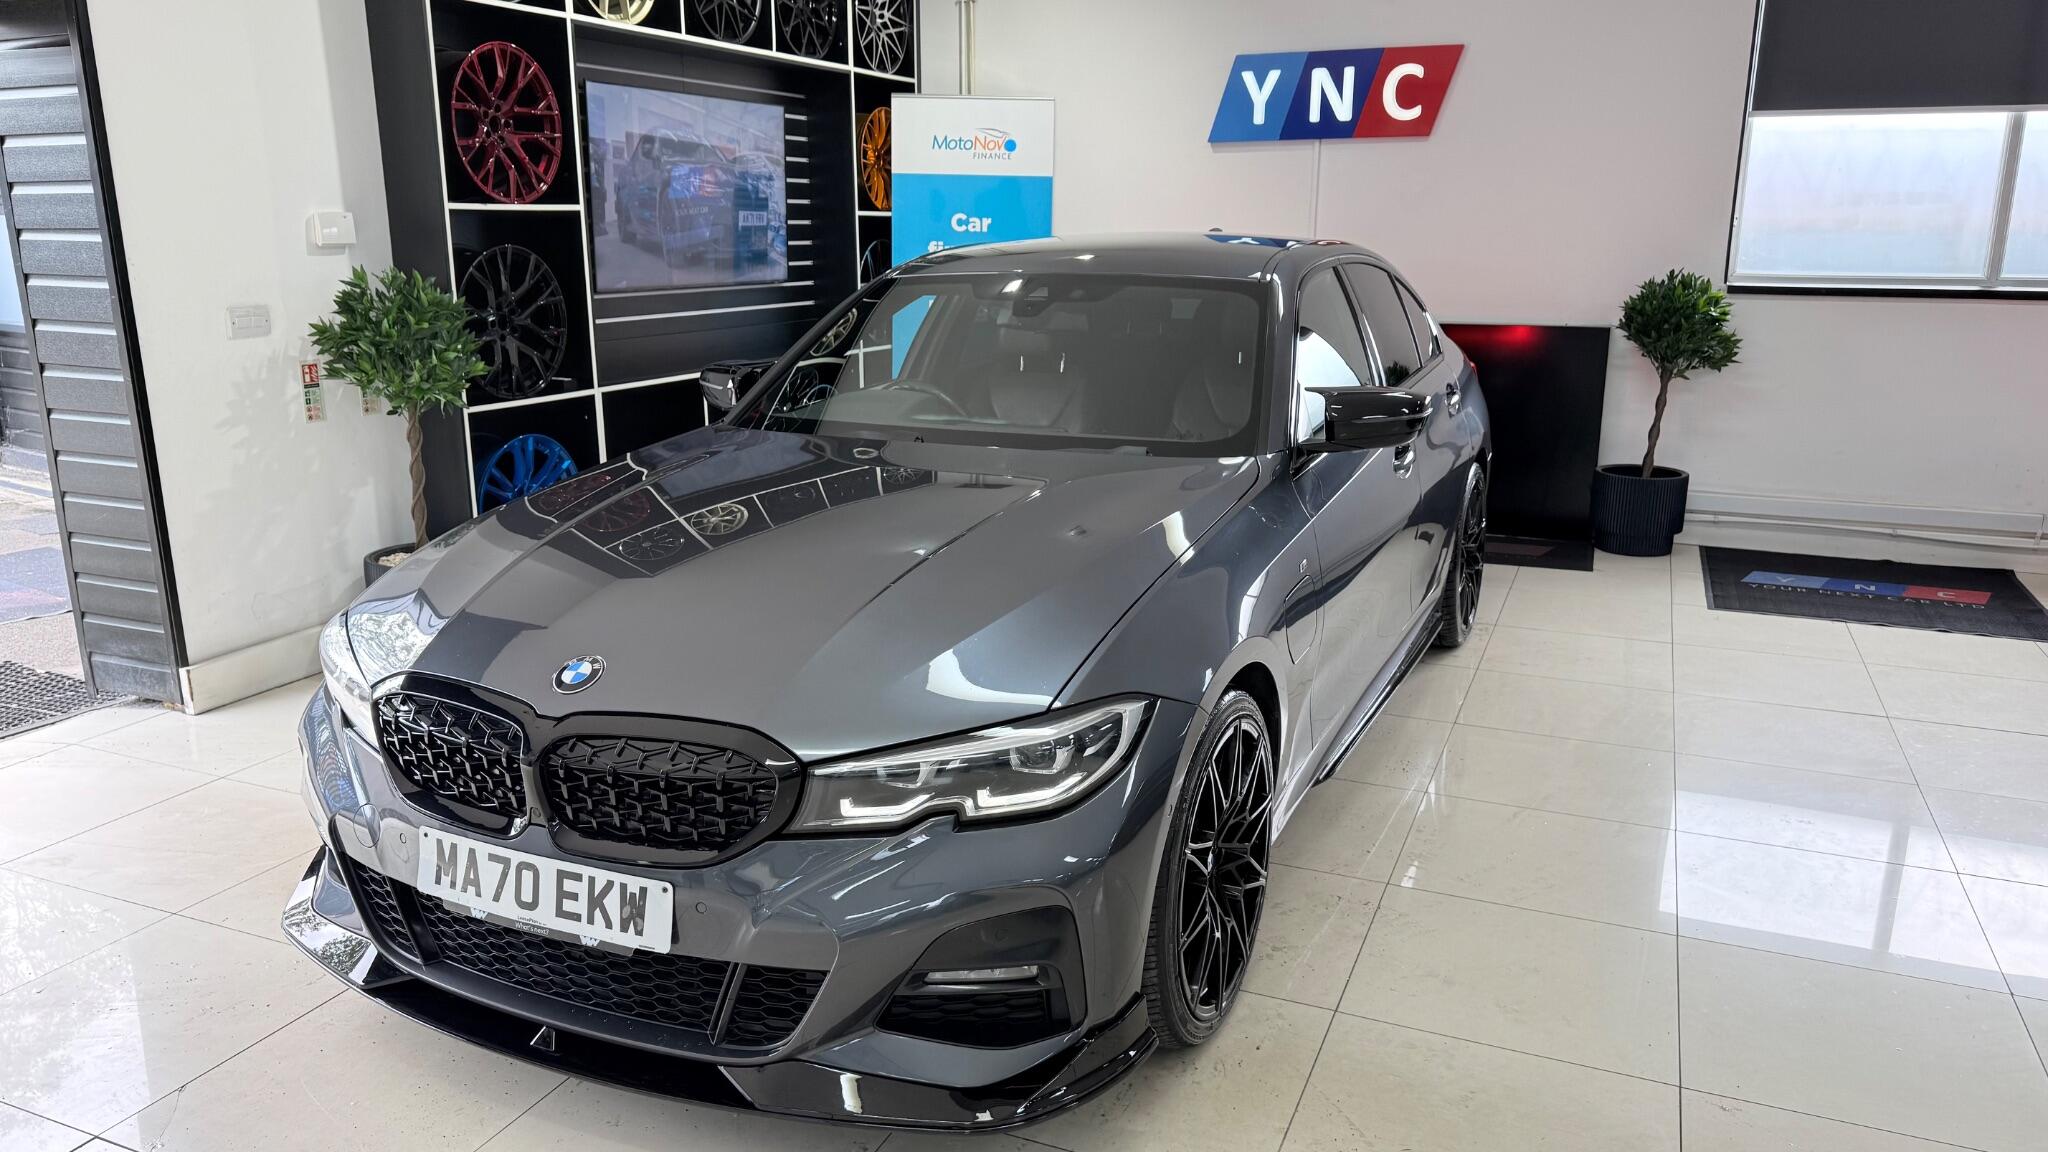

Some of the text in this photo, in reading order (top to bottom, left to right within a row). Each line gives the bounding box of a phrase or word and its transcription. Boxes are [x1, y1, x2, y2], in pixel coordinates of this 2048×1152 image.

[1241, 62, 1425, 125] YNC
[973, 152, 1012, 160] FINANCE
[951, 213, 992, 232] Car
[1749, 583, 1806, 592] YOUR
[434, 837, 648, 937] MA70 EKW
